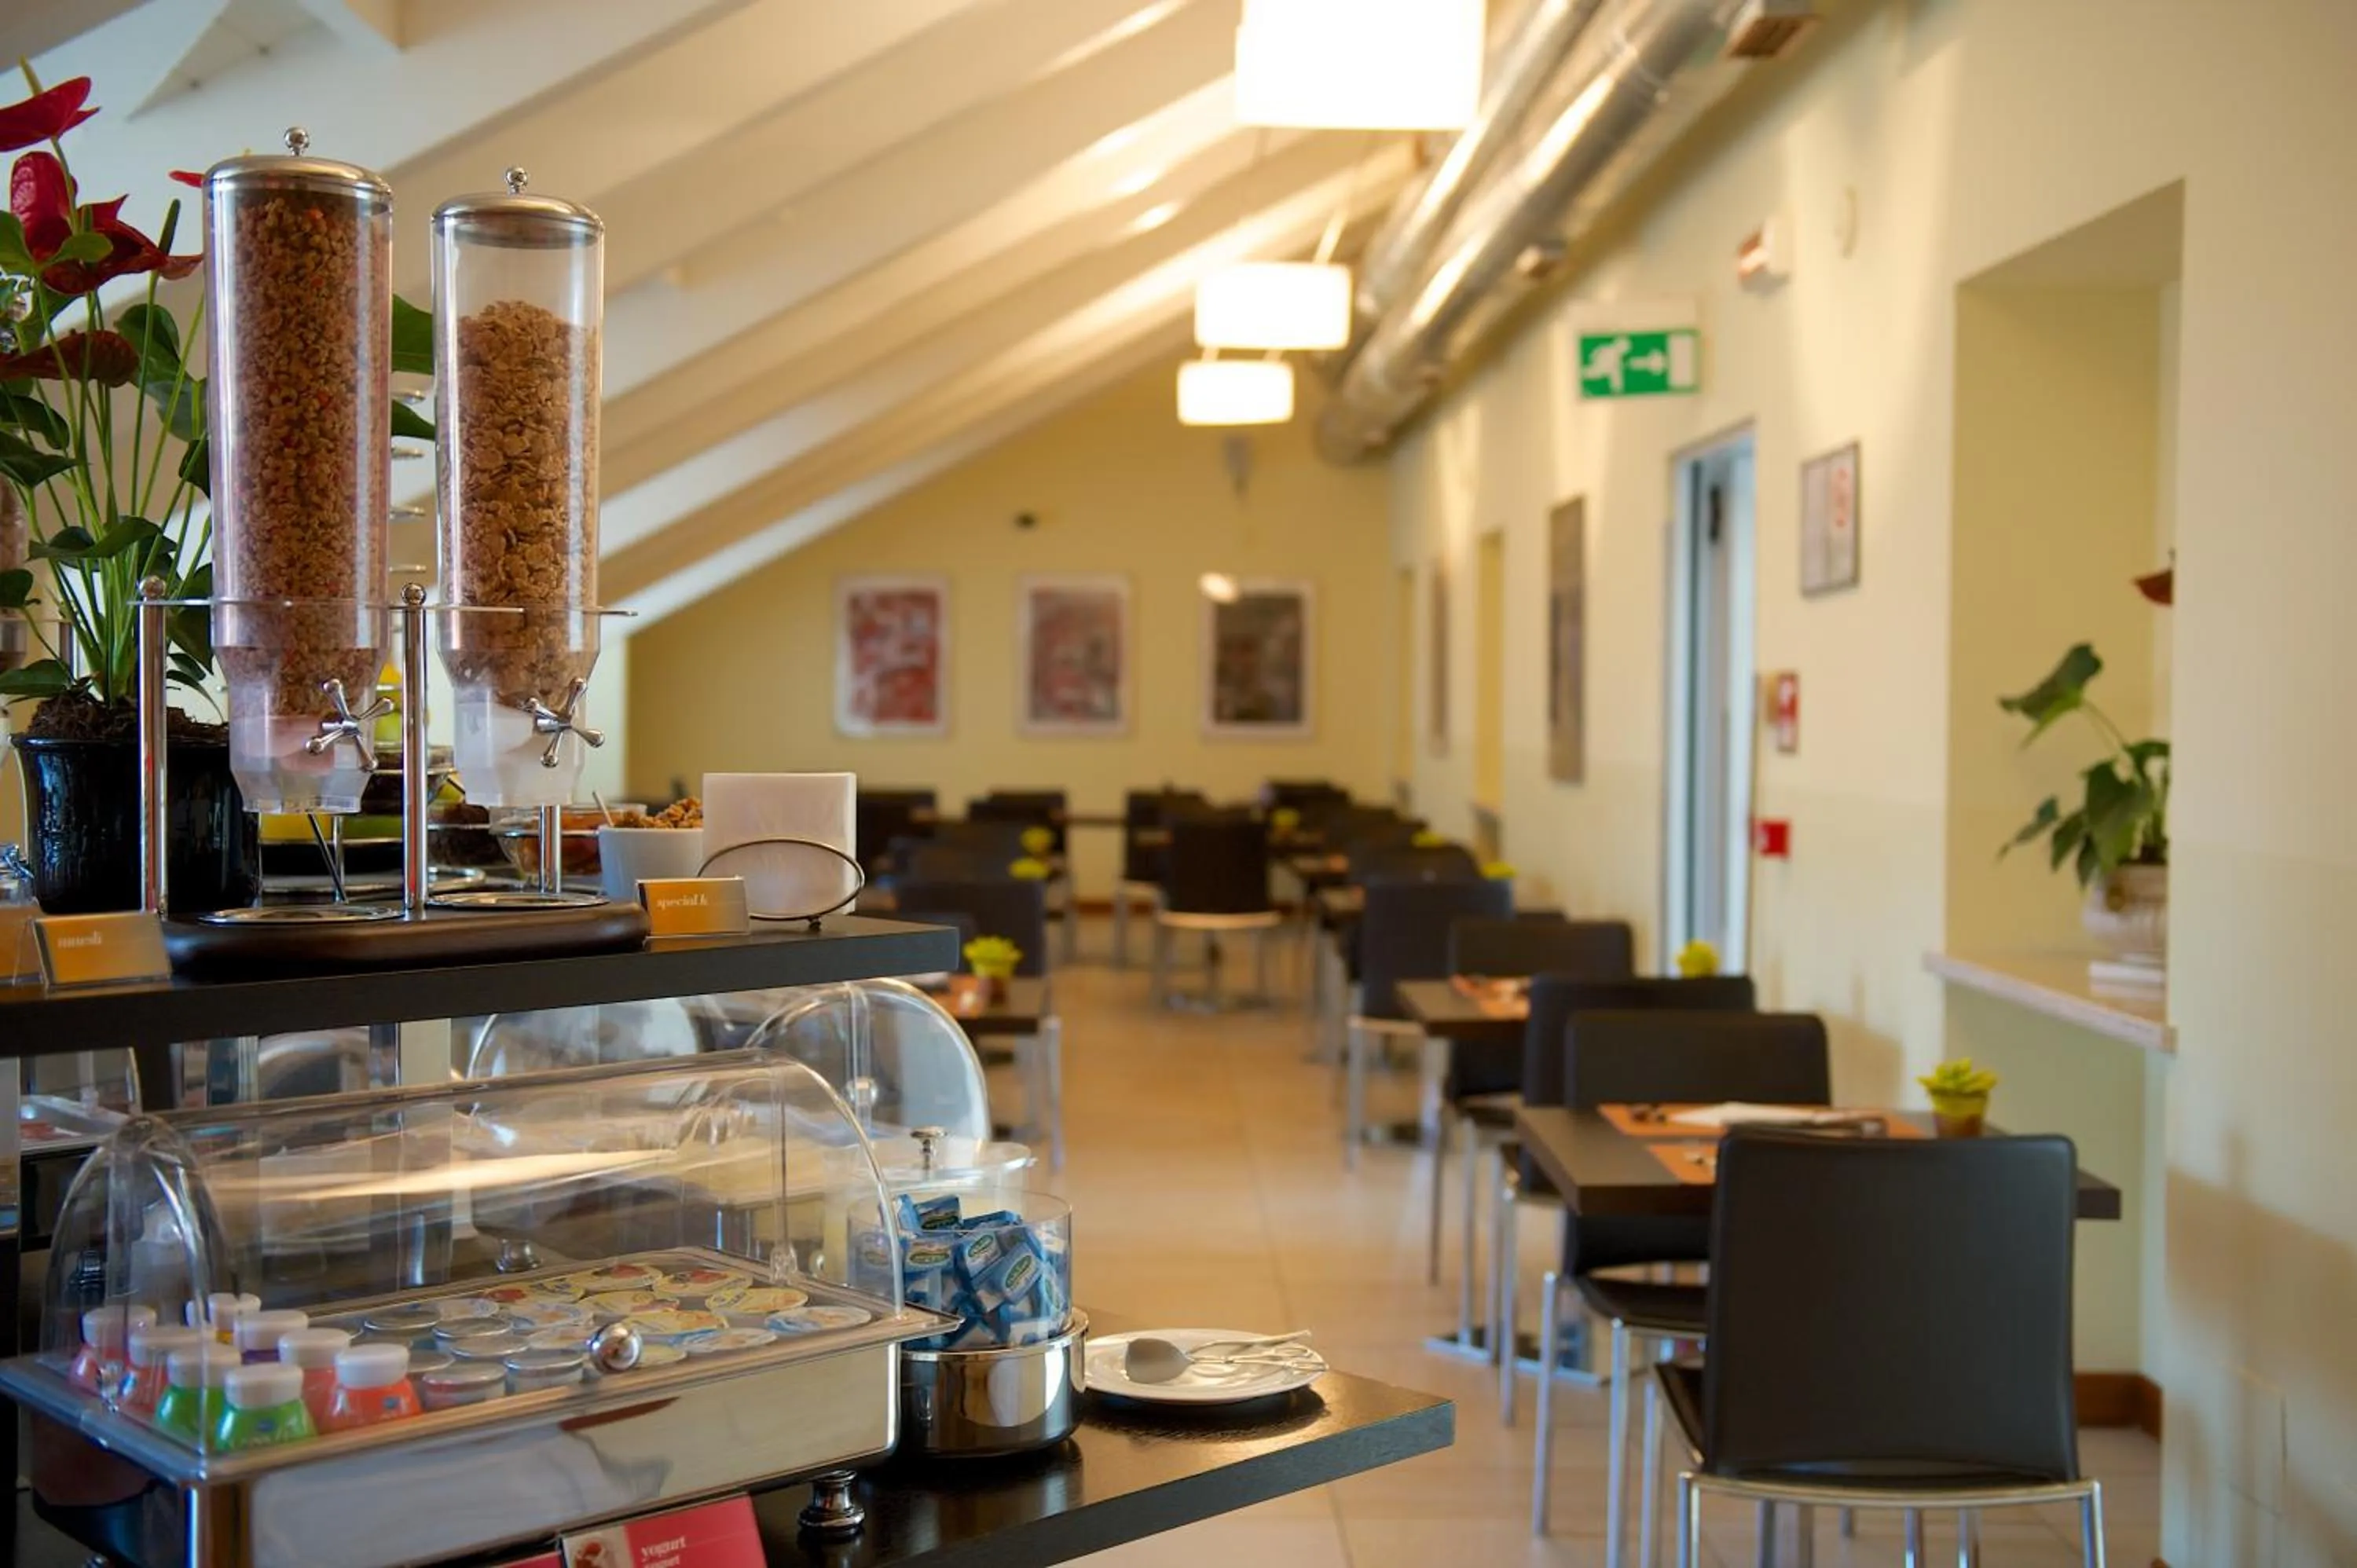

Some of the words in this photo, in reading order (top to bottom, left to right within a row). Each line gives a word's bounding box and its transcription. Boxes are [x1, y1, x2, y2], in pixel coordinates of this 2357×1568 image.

[657, 894, 698, 910] special
[57, 929, 102, 948] muesli
[641, 1536, 686, 1563] yogurt
